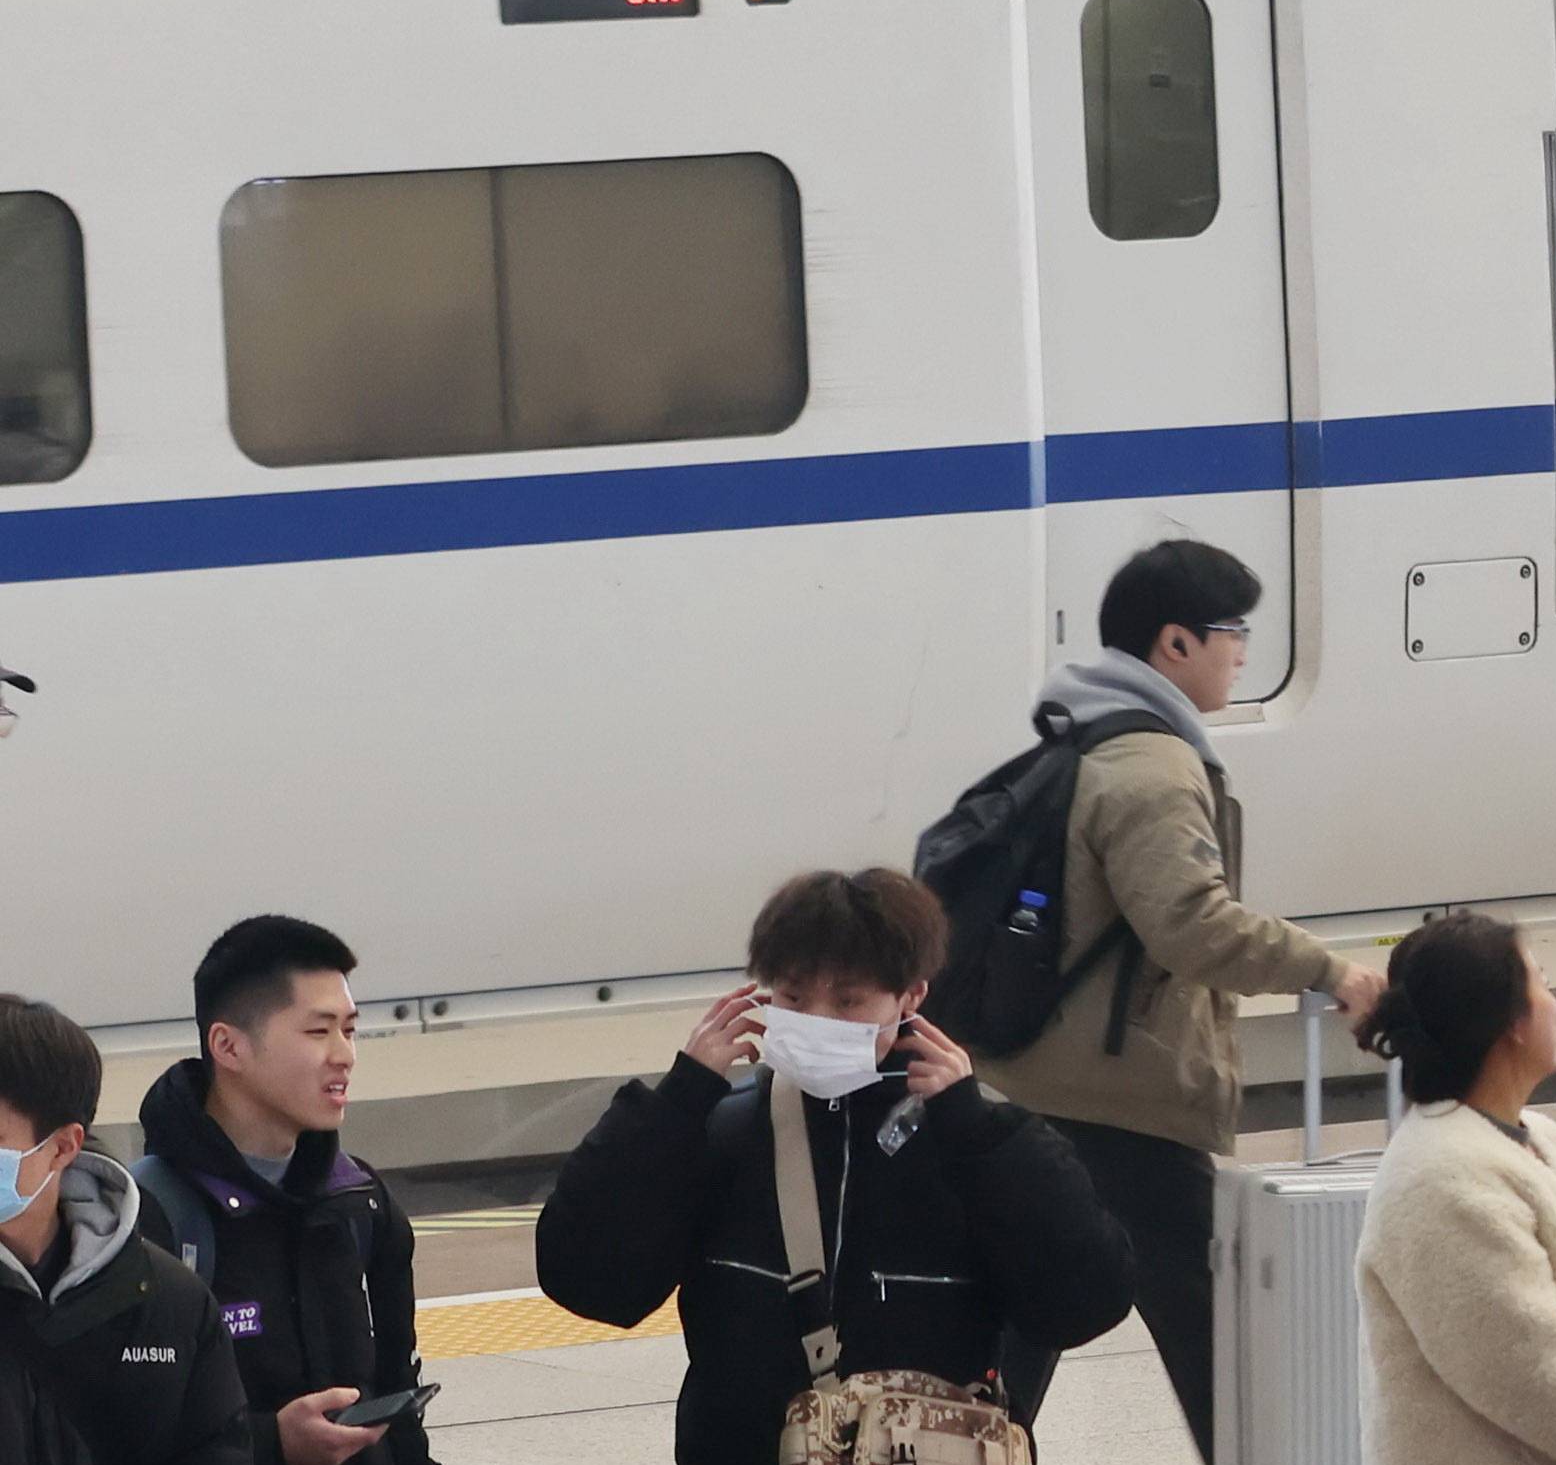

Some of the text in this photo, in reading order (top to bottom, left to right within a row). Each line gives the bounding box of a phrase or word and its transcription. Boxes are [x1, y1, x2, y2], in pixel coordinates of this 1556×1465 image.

[238, 1306, 256, 1320] TO
[228, 1319, 257, 1335] VEL
[121, 1346, 177, 1363] AUASUR
